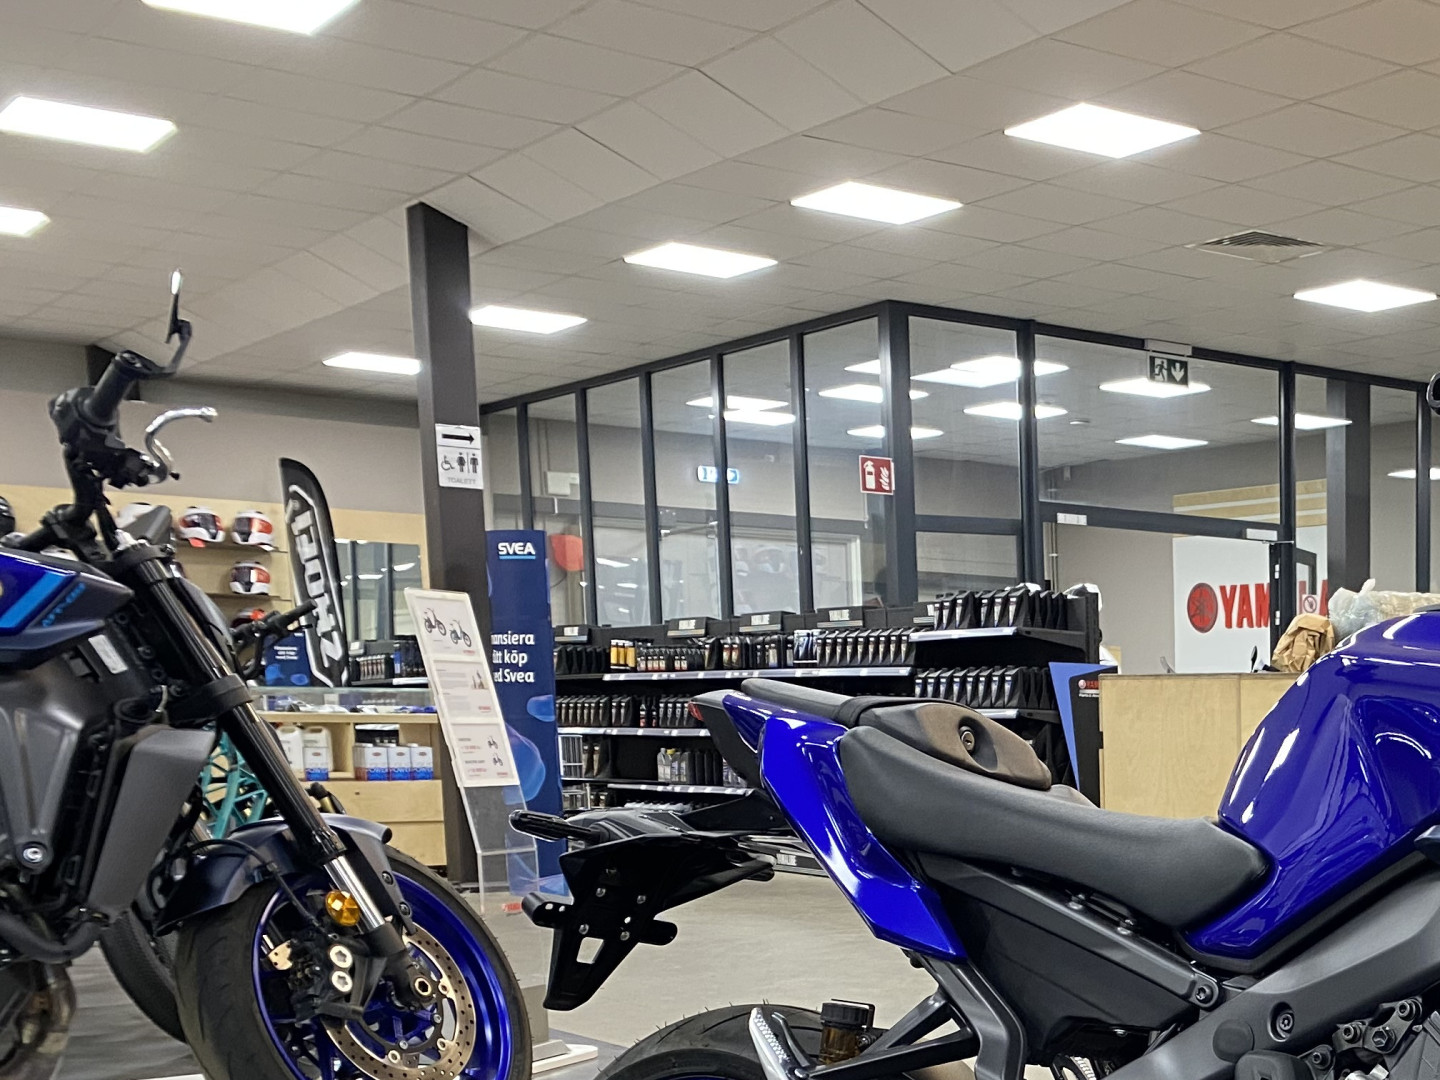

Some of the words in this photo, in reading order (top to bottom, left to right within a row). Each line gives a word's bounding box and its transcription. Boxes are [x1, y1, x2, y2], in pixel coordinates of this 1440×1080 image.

[498, 542, 536, 555] SVEA
[504, 649, 528, 668] köp
[504, 669, 535, 683] Svea
